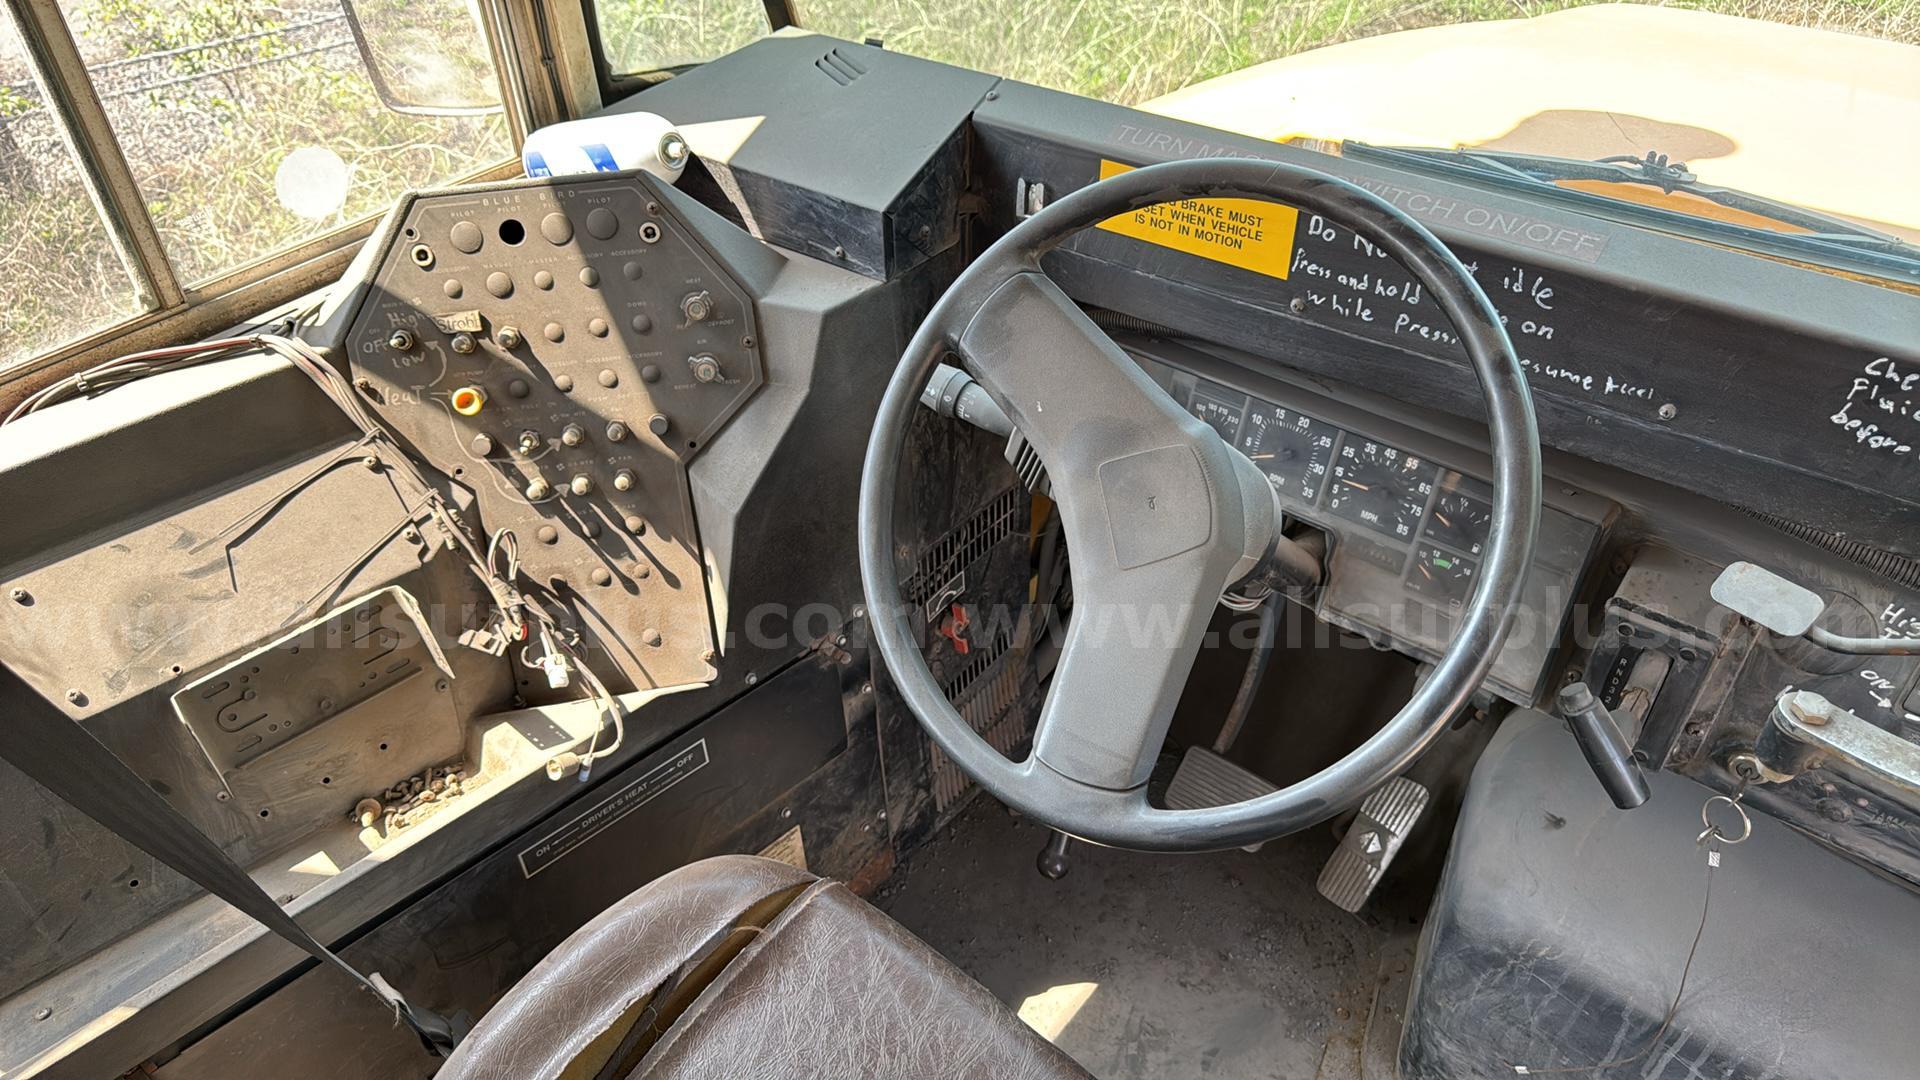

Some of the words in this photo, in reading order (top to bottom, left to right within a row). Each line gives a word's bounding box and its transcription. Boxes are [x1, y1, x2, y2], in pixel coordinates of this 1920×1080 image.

[1119, 124, 1193, 157] TURN
[1349, 177, 1457, 219] WITCH
[1464, 207, 1602, 252] ON/OFF
[482, 195, 522, 206] BLUE
[538, 190, 576, 201] BIRD
[1180, 199, 1224, 219] BRAKE
[1228, 210, 1265, 228] MUST
[1134, 212, 1146, 225] IS
[1149, 215, 1175, 231] NOT
[1178, 222, 1190, 236] IN
[1193, 226, 1243, 250] MOTION
[1170, 209, 1207, 228] WHEN
[1211, 220, 1264, 242] VEHICLE
[1308, 214, 1337, 242] Do
[1337, 270, 1369, 292] and
[1374, 278, 1421, 306] hold
[1519, 358, 1594, 392] esume
[1251, 413, 1263, 425] 10
[1275, 408, 1286, 419] 15
[1297, 416, 1310, 428] 20
[1319, 435, 1332, 448] 25
[1364, 442, 1377, 454] 35
[1342, 446, 1355, 458] 25
[1384, 447, 1397, 460] 45
[1312, 462, 1325, 475] 30
[1405, 457, 1419, 470] 55
[1302, 486, 1314, 498] 35
[1331, 483, 1340, 494] 5
[1418, 482, 1432, 495] 65
[1360, 510, 1379, 523] MPH
[1410, 504, 1423, 517] 75
[1396, 523, 1409, 536] 85
[1620, 657, 1628, 667] R
[1616, 667, 1624, 677] N
[1608, 686, 1616, 695] 3
[535, 844, 551, 858] ON
[580, 797, 625, 830] DRIVER'S
[624, 781, 649, 802] HEAT
[676, 752, 694, 769] OFF
